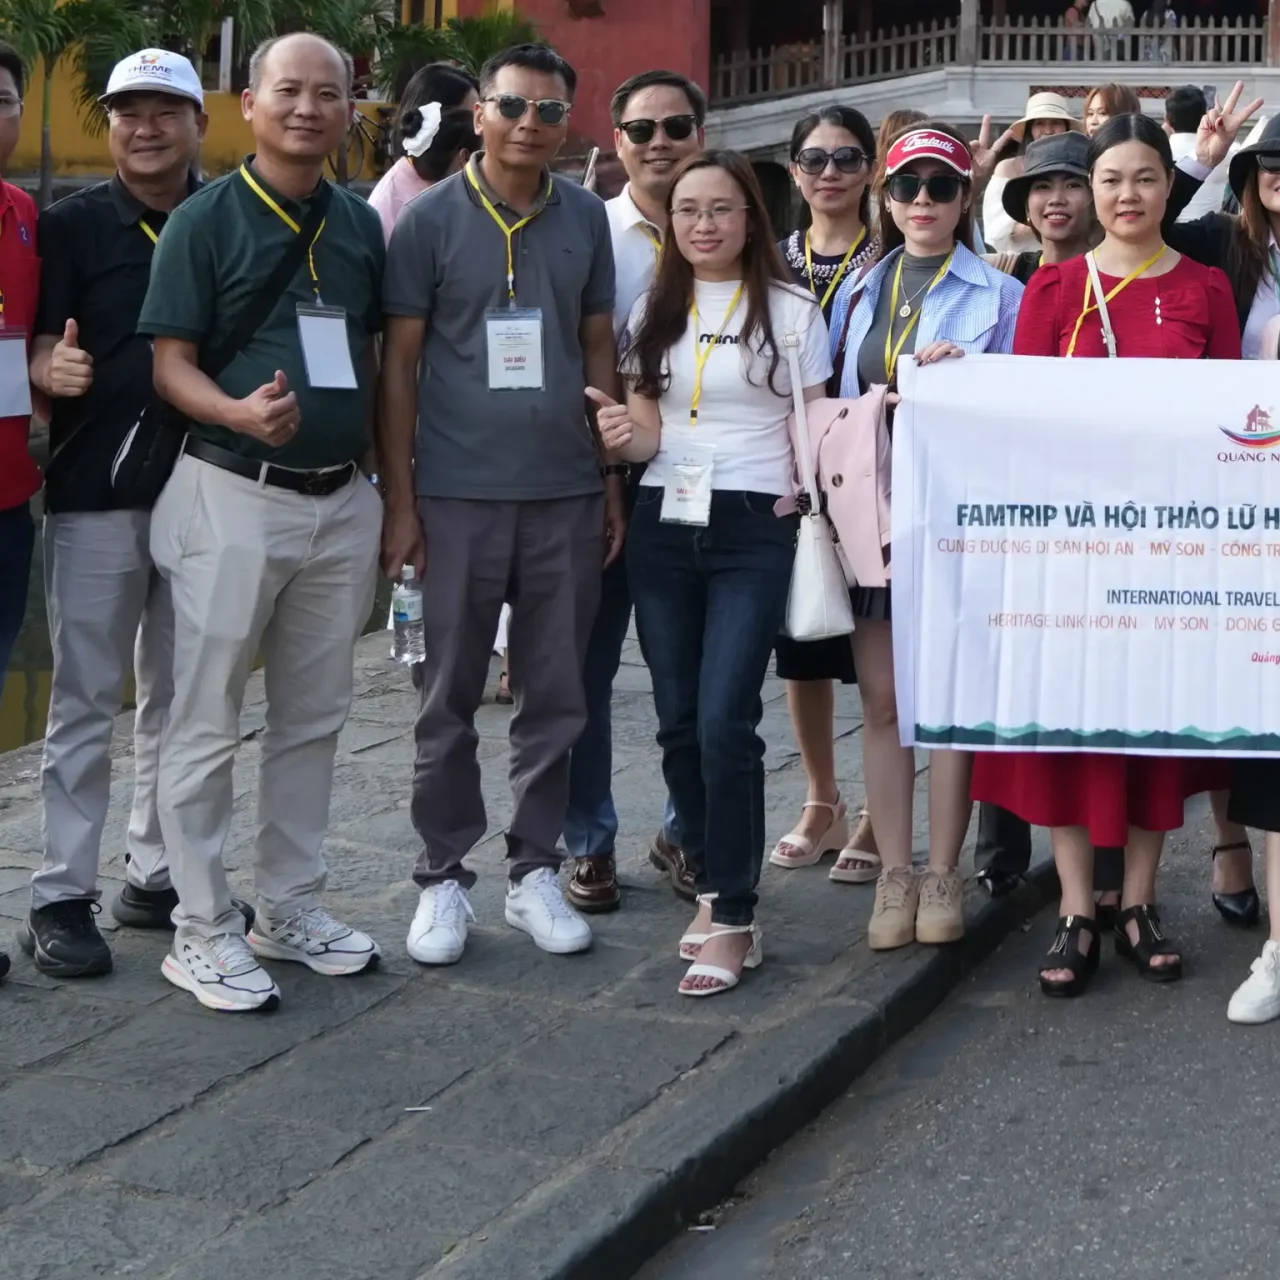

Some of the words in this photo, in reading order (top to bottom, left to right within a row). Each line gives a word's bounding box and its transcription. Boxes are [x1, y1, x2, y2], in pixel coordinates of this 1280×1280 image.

[901, 133, 955, 154] Fantastic
[956, 504, 1058, 527] FAMTRIP
[1065, 500, 1096, 528] VÀ
[1104, 500, 1146, 531] HỘI
[1154, 500, 1219, 529] THẢO
[1227, 503, 1257, 530] LỮ
[937, 538, 976, 553] CUNG
[1036, 540, 1049, 554] DI
[1114, 541, 1134, 556] AN
[1106, 589, 1221, 606] INTERNATIONAL
[1225, 591, 1280, 607] TRAVEL
[988, 613, 1051, 628] HERITAGE
[1055, 614, 1085, 628] LINK
[1089, 615, 1114, 629] HOI
[1118, 615, 1137, 630] AN
[1154, 616, 1176, 630] MY
[1180, 616, 1209, 631] SON
[1226, 617, 1267, 632] DONG
[1251, 652, 1280, 665] Quảng
